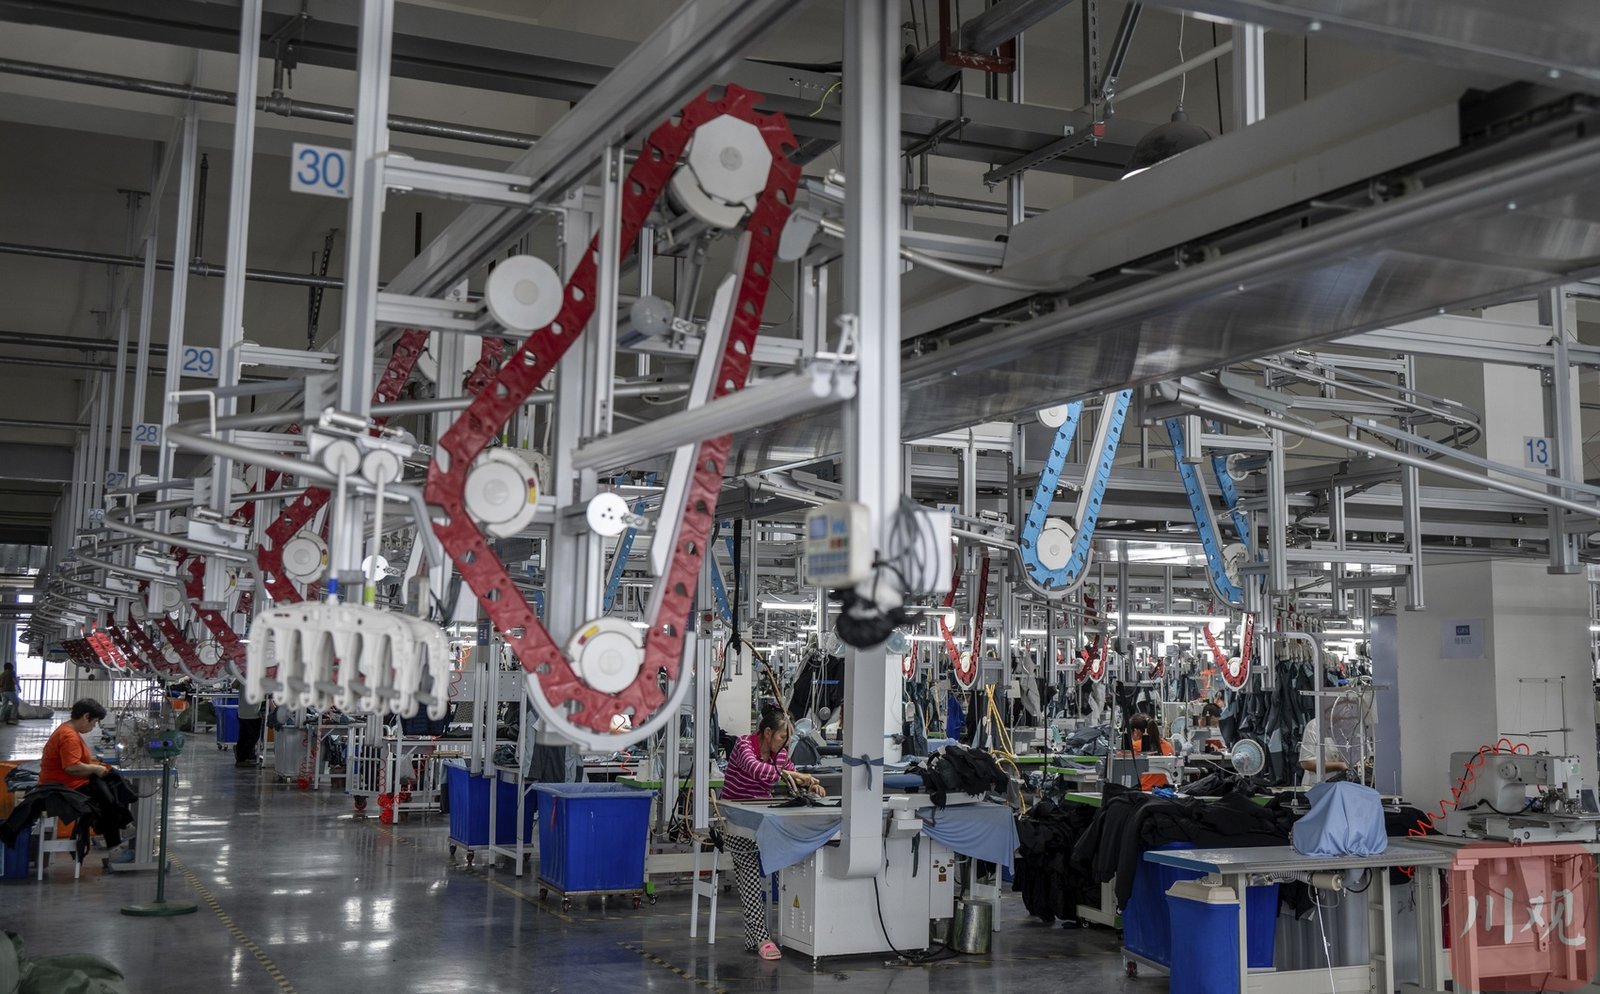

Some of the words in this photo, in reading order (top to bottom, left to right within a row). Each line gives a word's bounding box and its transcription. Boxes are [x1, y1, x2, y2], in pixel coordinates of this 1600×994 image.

[297, 149, 345, 189] 30
[183, 348, 214, 373] 29
[135, 424, 158, 442] 28
[1526, 439, 1548, 464] 13
[106, 472, 125, 486] 27
[88, 509, 103, 521] 26
